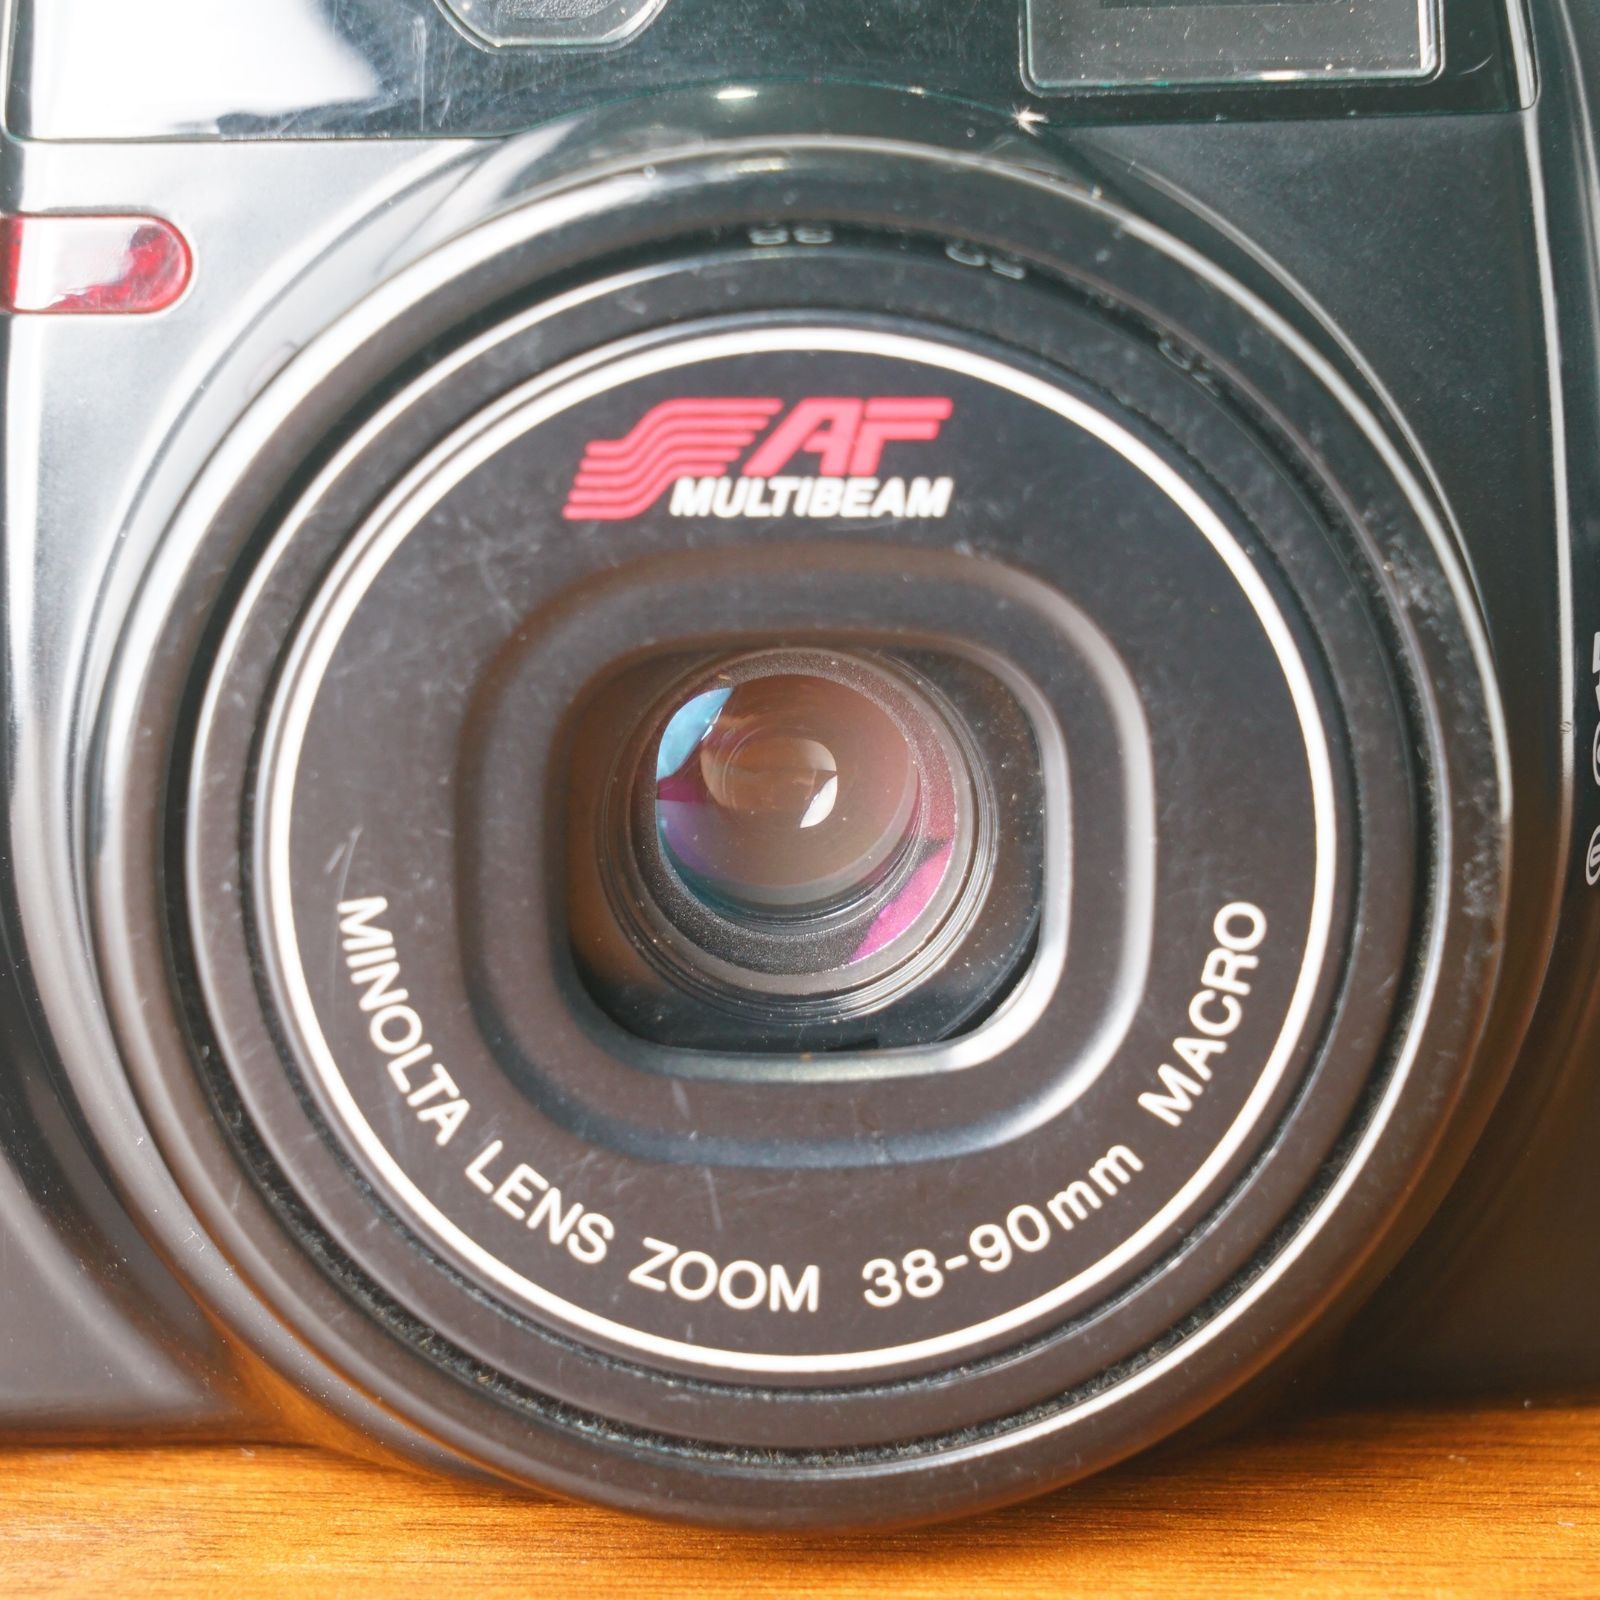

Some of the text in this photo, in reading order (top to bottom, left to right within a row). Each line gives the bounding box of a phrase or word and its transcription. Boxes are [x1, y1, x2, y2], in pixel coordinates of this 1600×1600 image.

[741, 397, 953, 477] AF
[669, 476, 954, 518] MULTIBEAM
[337, 896, 1267, 1313] MINOLTA LENS ZOOM 38-90mm MACRO
